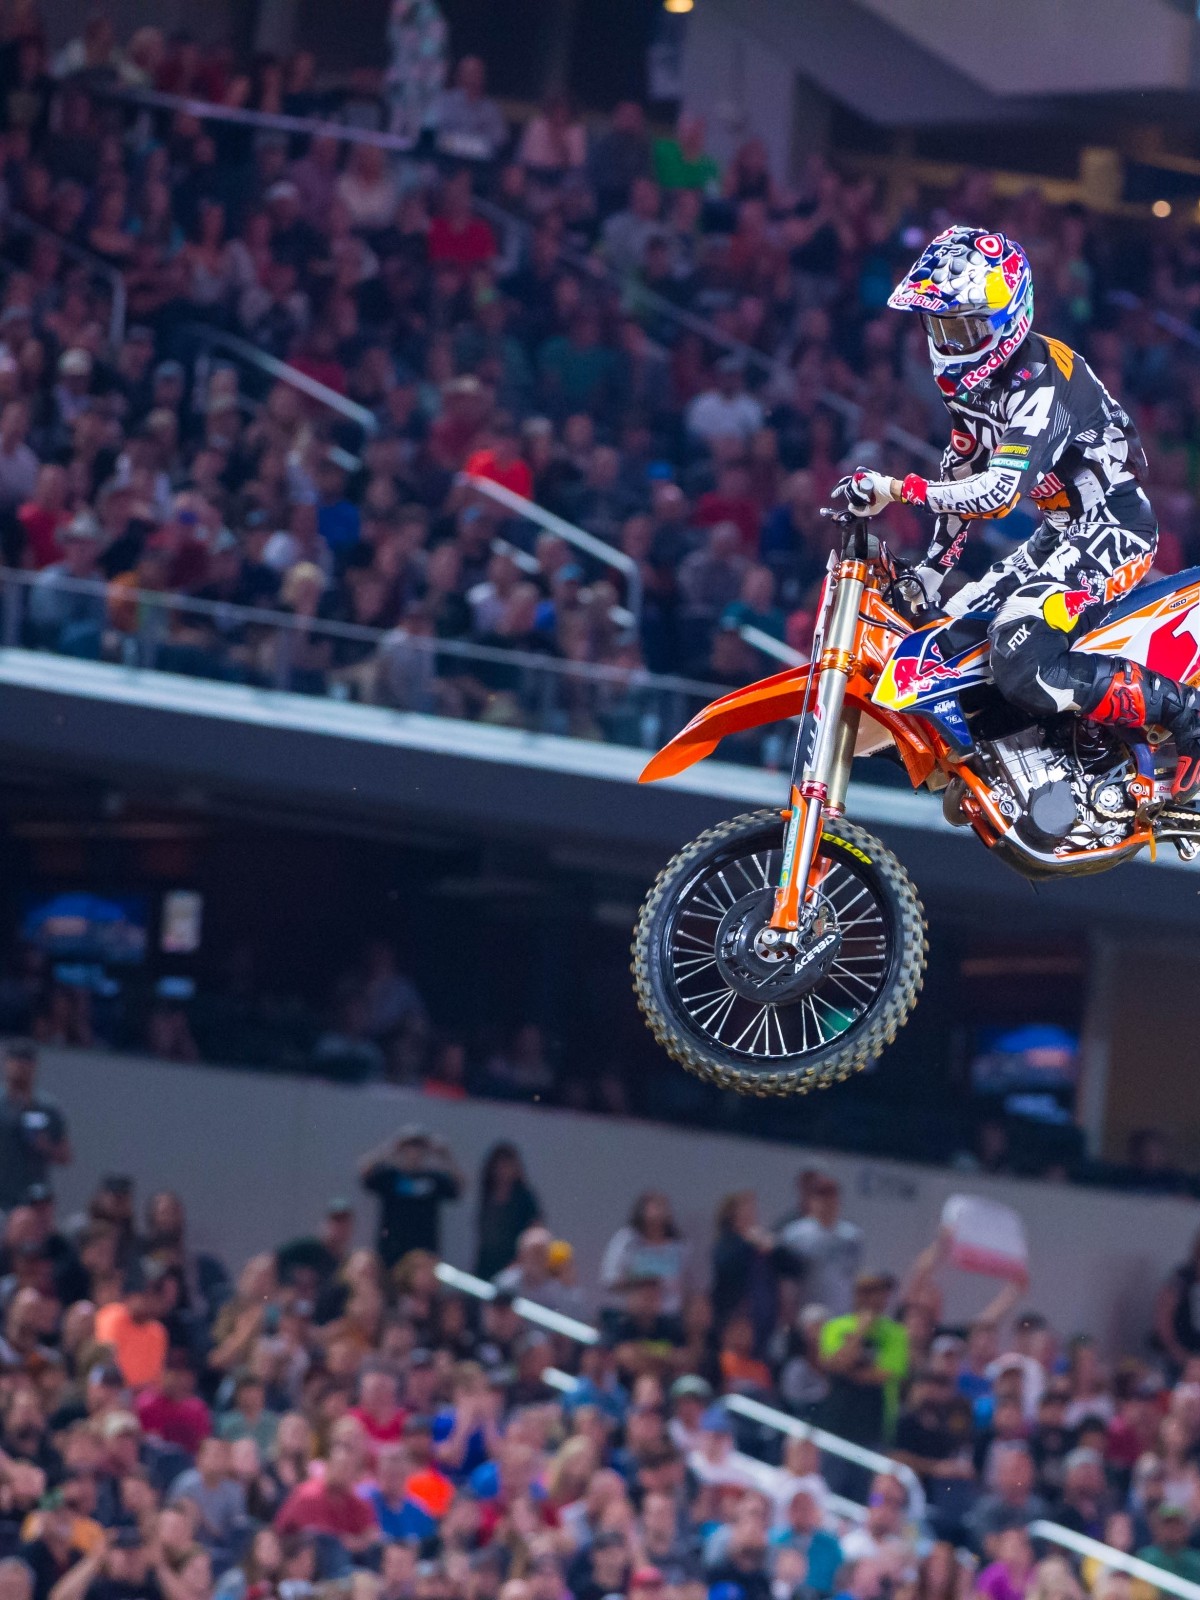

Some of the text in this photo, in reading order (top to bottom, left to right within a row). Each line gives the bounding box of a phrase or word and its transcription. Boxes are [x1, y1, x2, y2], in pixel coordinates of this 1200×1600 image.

[889, 292, 943, 310] Red Bull
[960, 349, 1004, 390] Red
[998, 314, 1030, 358] Bull
[955, 473, 1016, 513] SIXTEEN
[1169, 598, 1187, 609] 450
[1007, 623, 1031, 651] FOX
[933, 700, 956, 714] KTM
